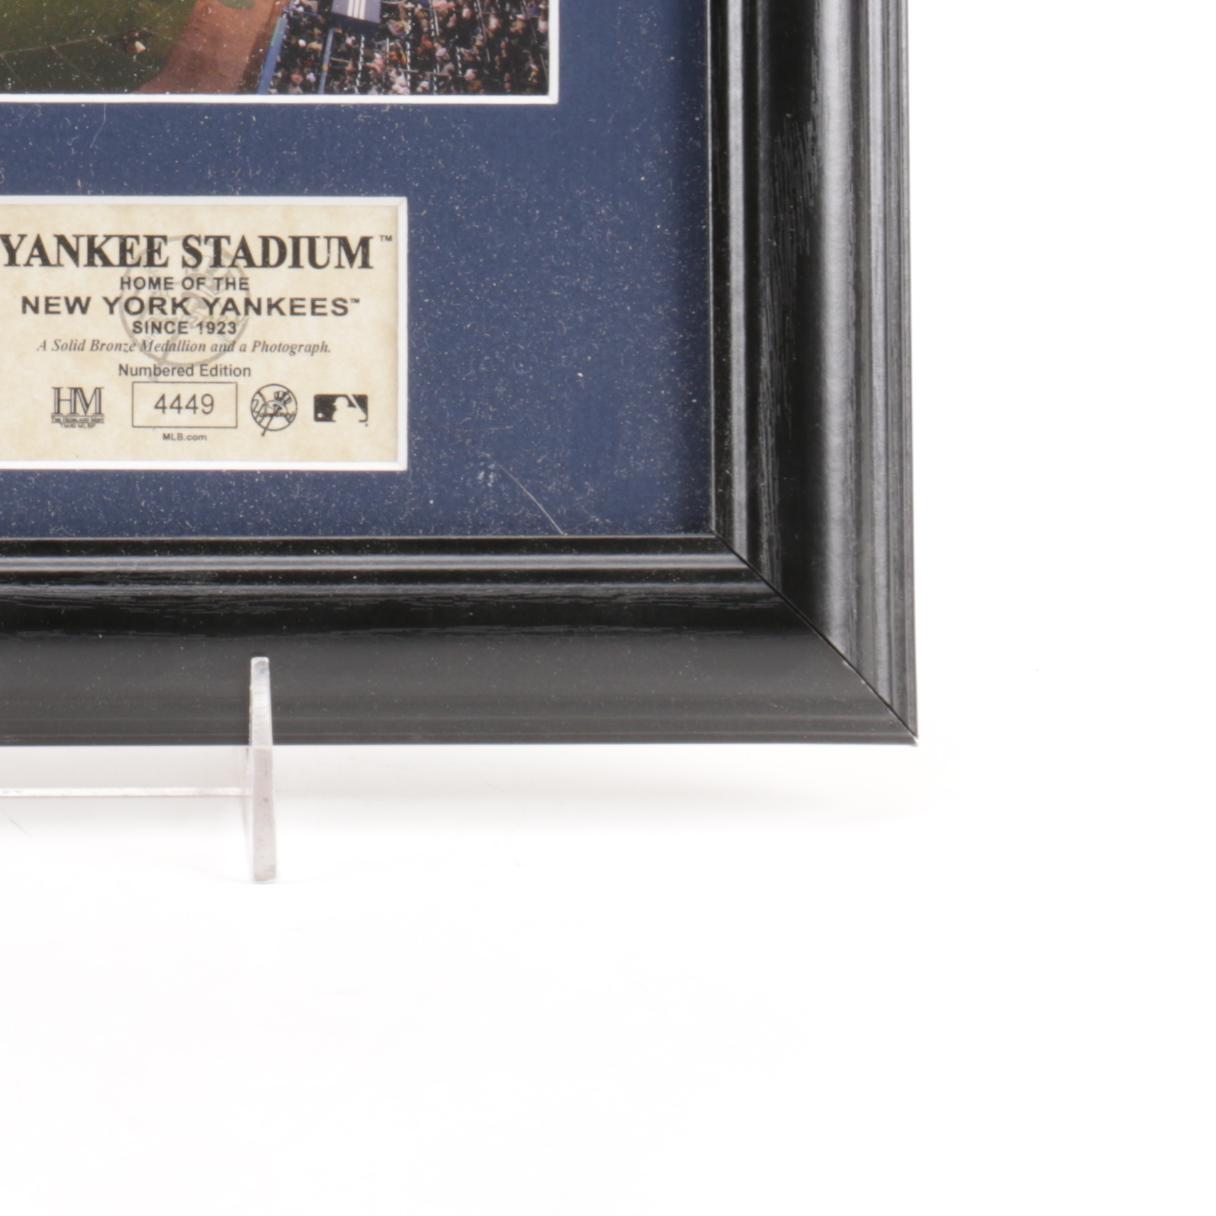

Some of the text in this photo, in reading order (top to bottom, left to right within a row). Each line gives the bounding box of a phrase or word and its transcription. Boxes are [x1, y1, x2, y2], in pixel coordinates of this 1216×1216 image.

[120, 277, 250, 291] HOME OF THE
[21, 297, 91, 316] NEW
[104, 297, 188, 316] YORK
[132, 321, 237, 335] SINCE 1923
[36, 339, 332, 356] A Solid Bronze Medallion and a Photograph.
[119, 364, 252, 378] Numbered Edition
[51, 386, 105, 415] HM
[154, 393, 215, 415] 4449
[162, 433, 208, 442] MLB.com
